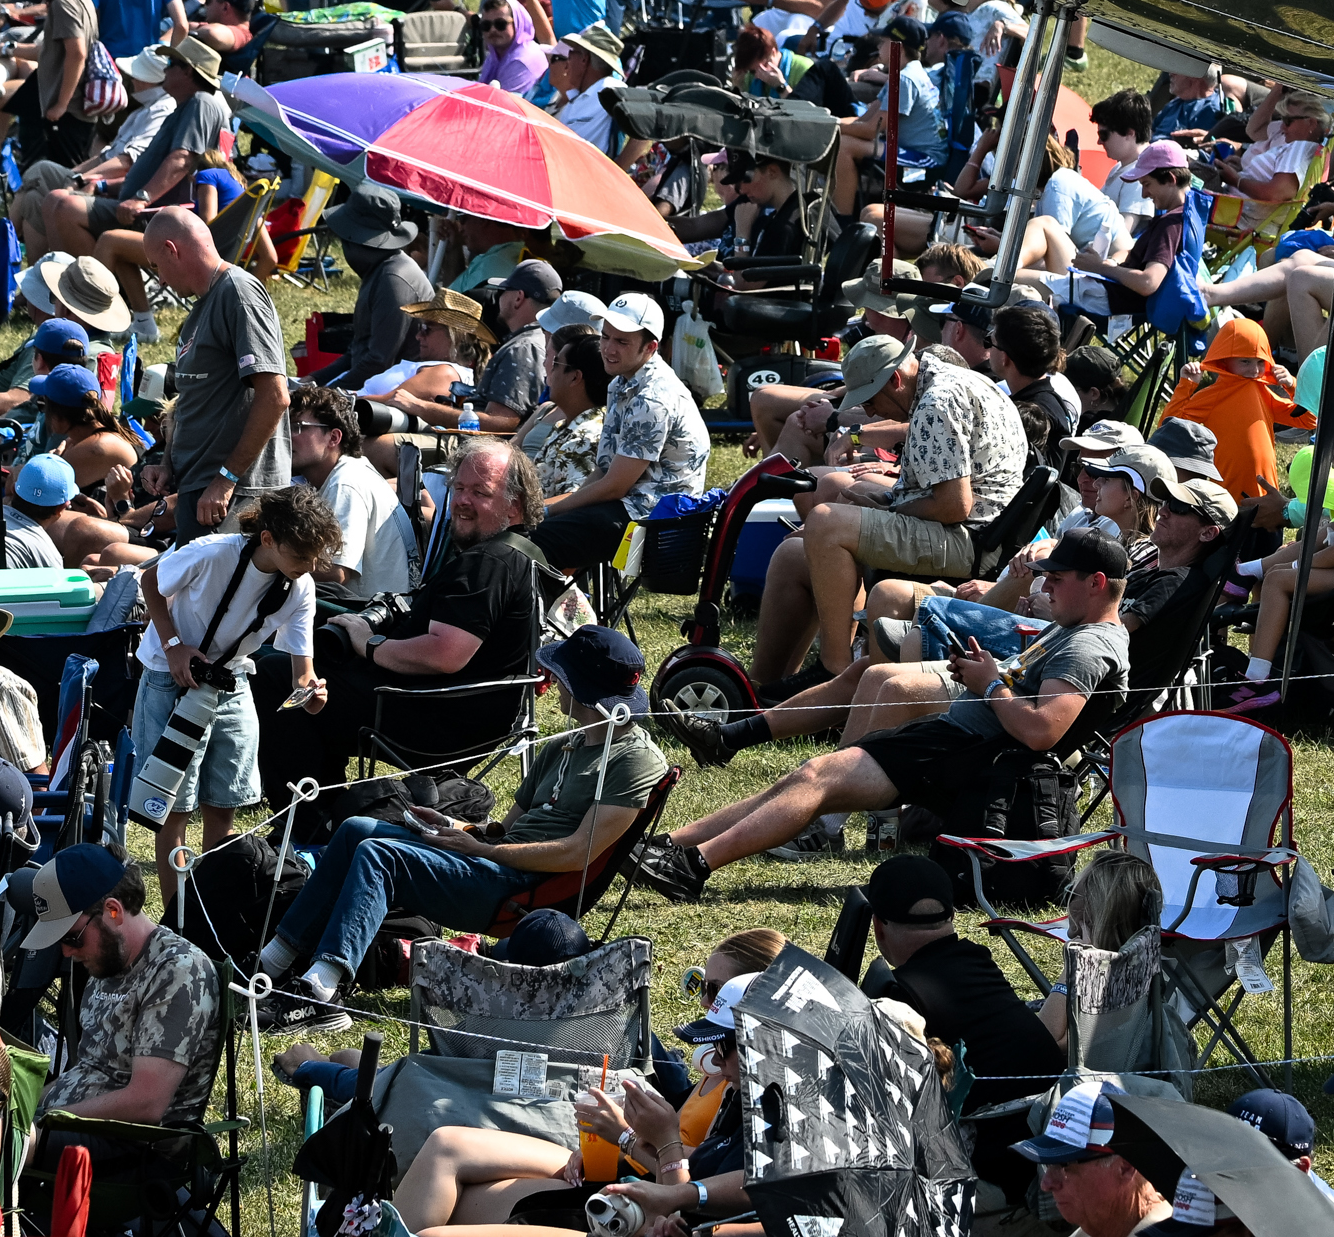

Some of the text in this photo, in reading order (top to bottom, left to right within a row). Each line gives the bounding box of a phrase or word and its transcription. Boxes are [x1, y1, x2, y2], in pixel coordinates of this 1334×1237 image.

[752, 374, 776, 384] 46
[33, 488, 43, 497] 19
[283, 1005, 316, 1022] HOKA
[693, 1033, 726, 1042] OSHKOSH
[1240, 1109, 1263, 1124] TEAM
